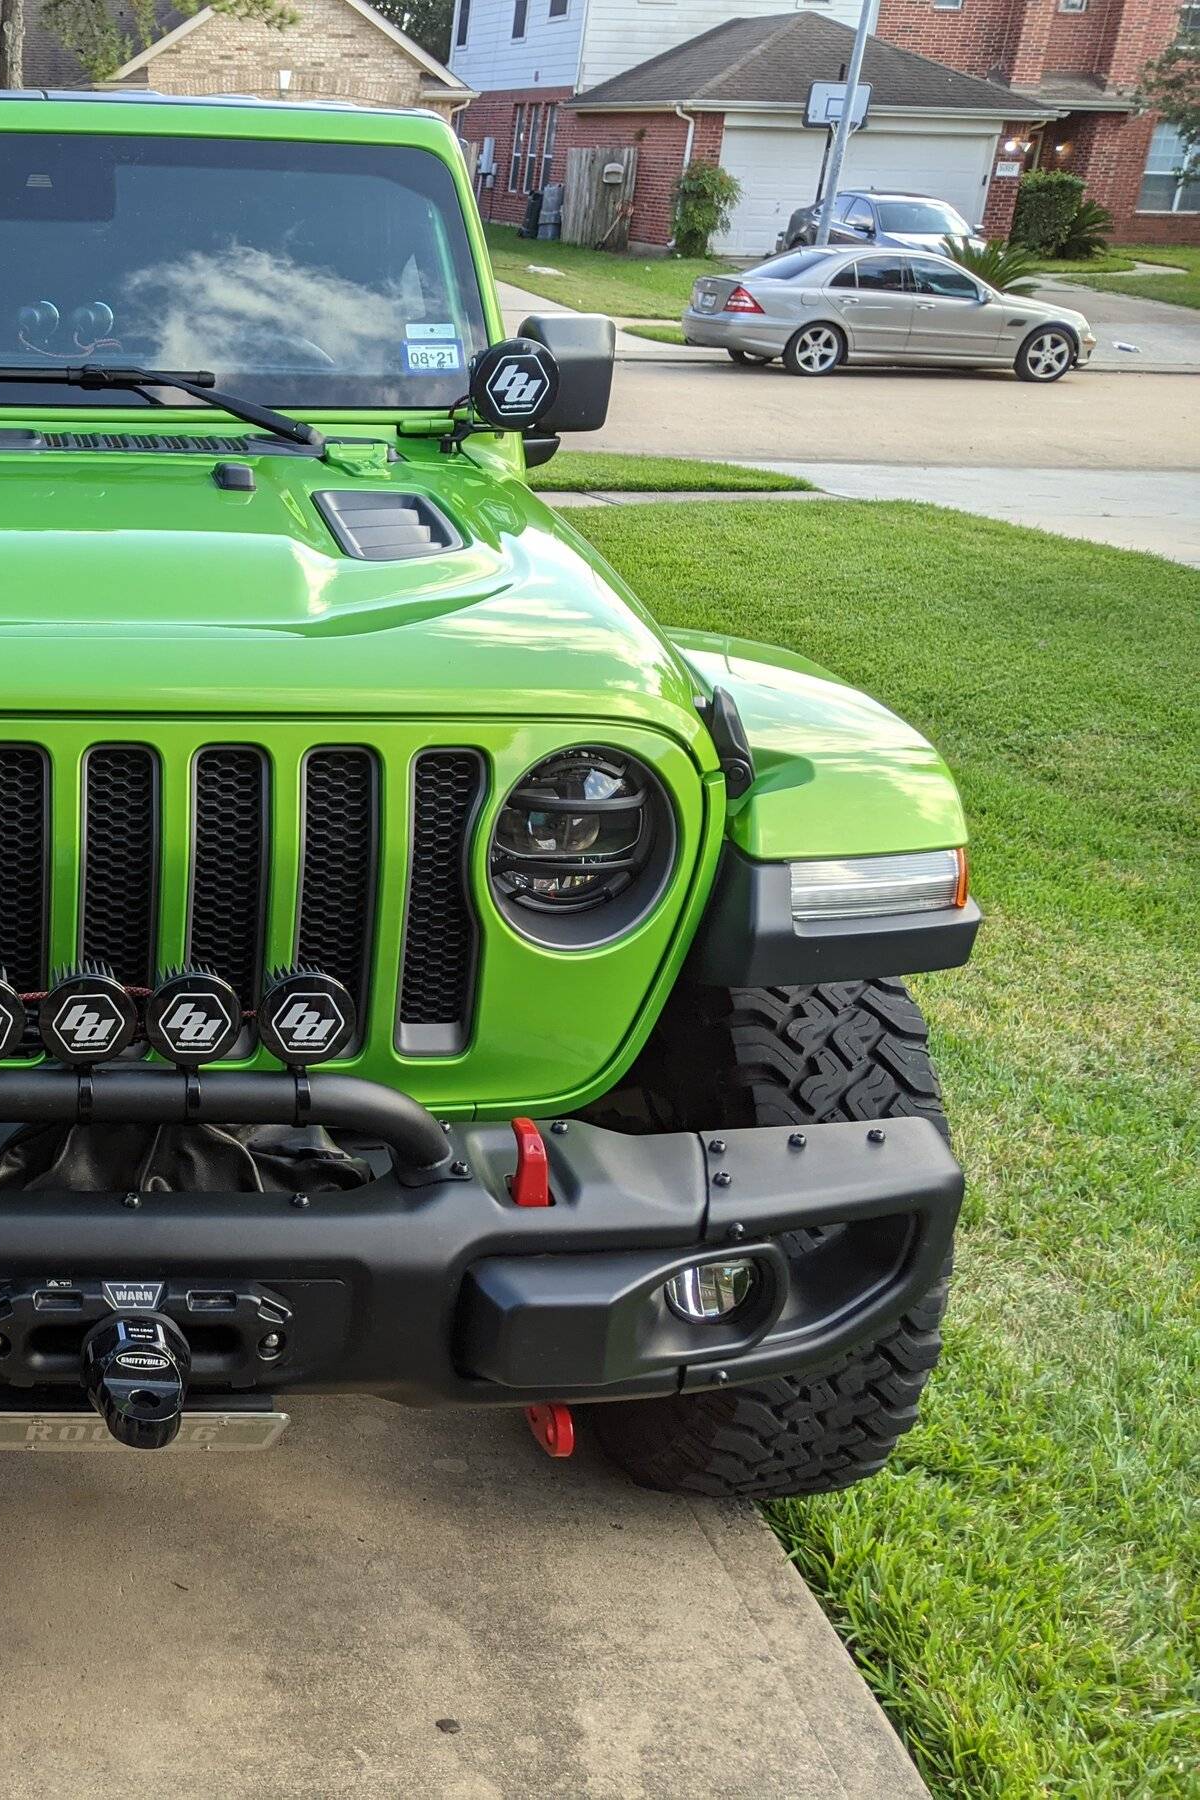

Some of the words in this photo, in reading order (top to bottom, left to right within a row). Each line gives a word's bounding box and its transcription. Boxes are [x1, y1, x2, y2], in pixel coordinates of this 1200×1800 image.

[410, 352, 429, 365] 08
[436, 351, 454, 364] 21
[60, 1005, 115, 1040] bd
[166, 1003, 223, 1040] bd
[279, 1003, 335, 1040] bd
[115, 1291, 154, 1301] WARN
